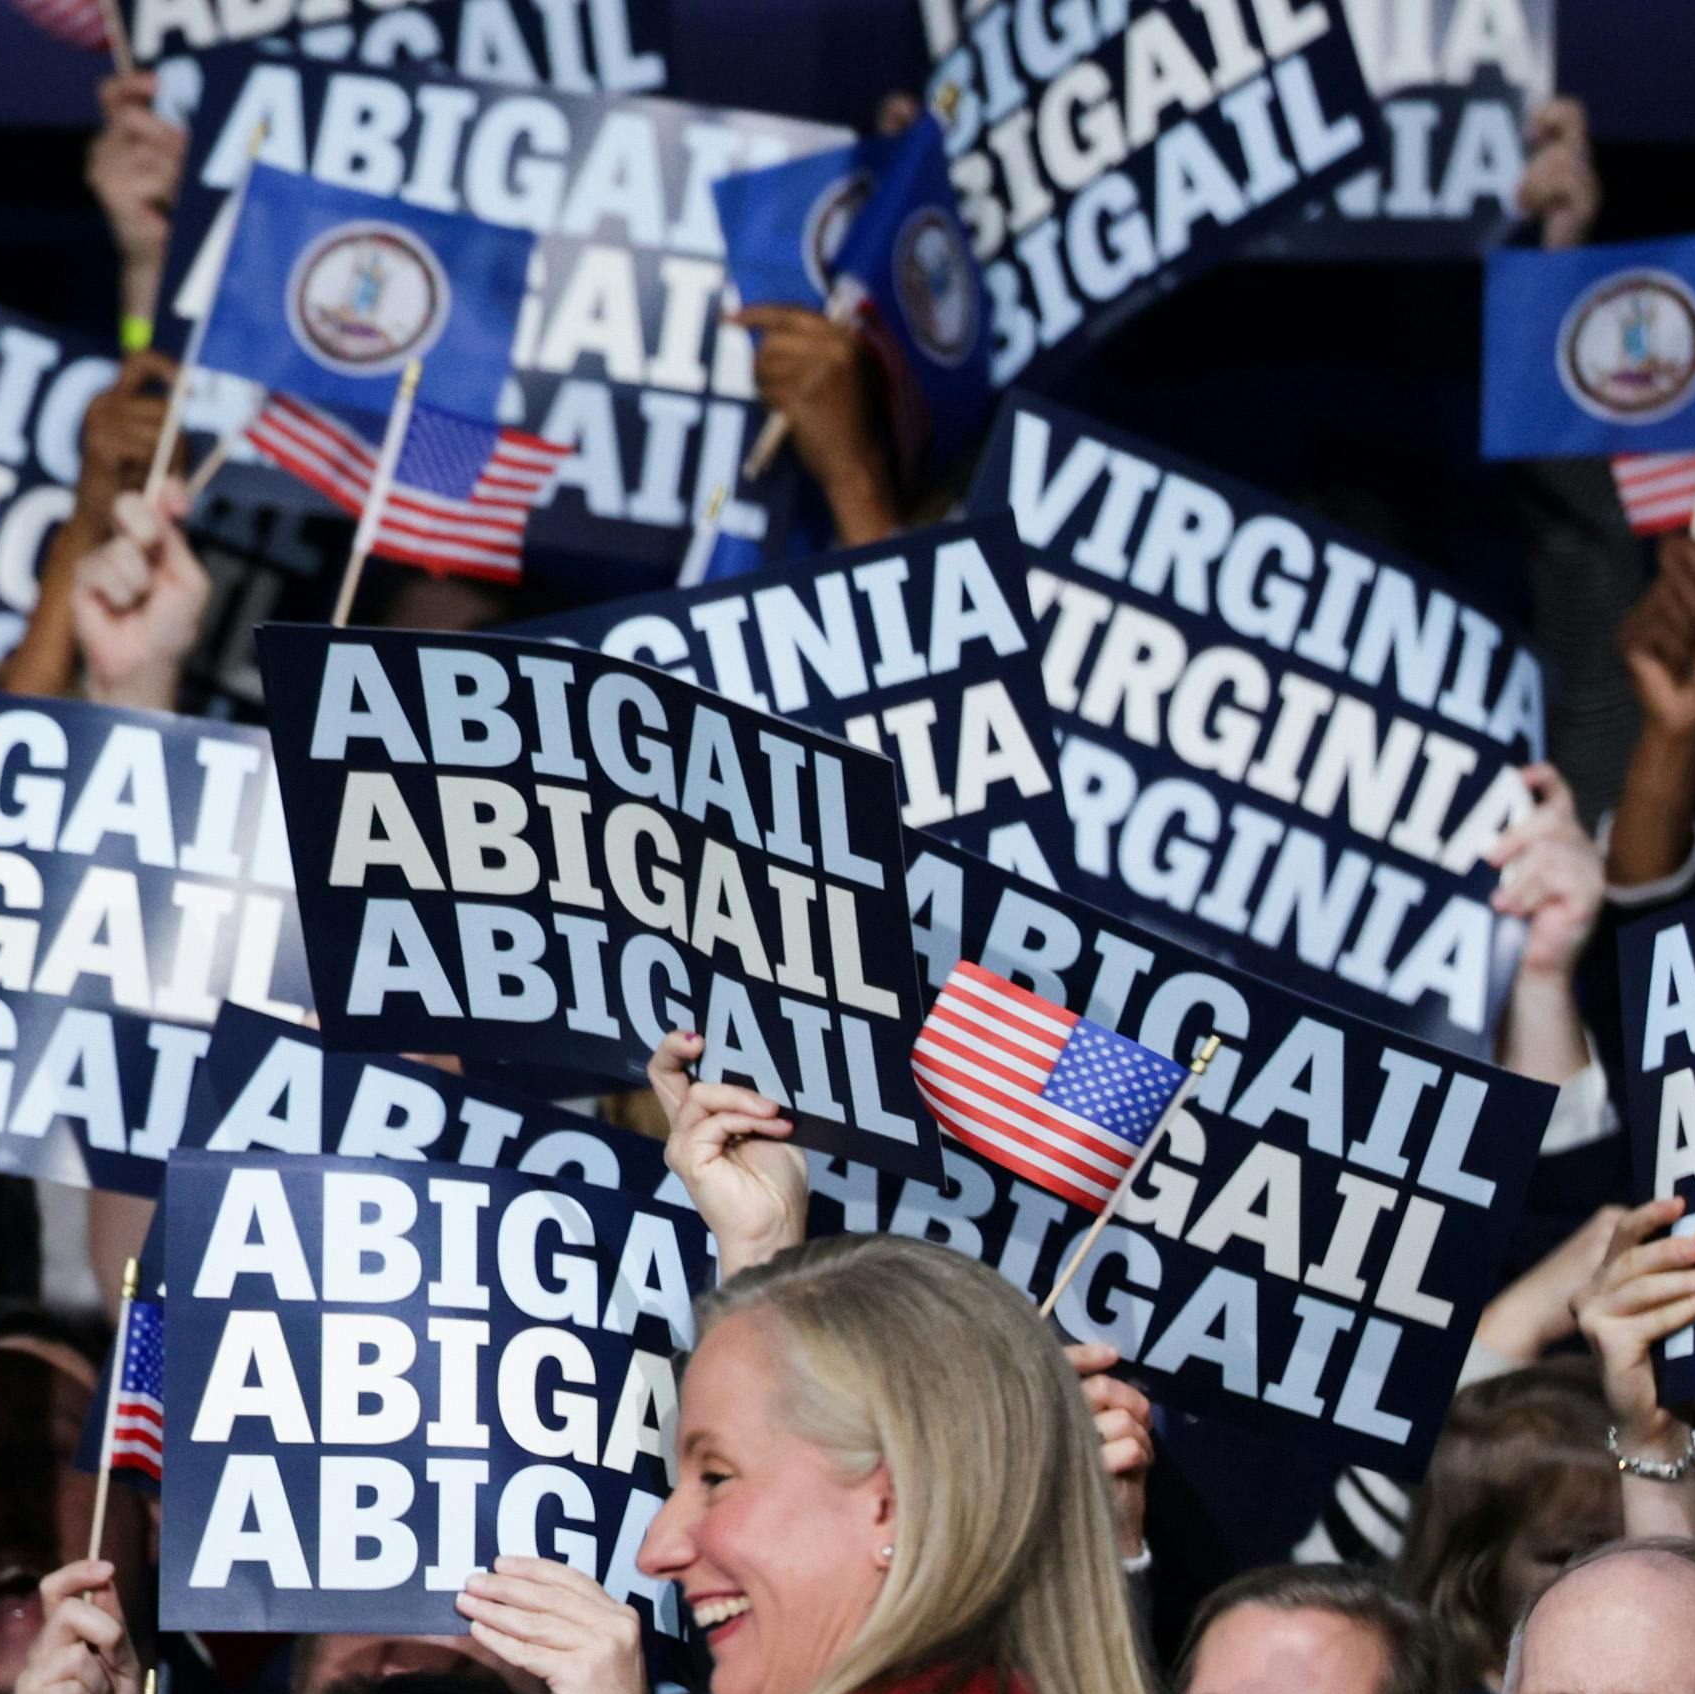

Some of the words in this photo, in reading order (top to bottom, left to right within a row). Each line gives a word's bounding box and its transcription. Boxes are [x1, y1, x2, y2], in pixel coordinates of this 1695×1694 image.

[201, 63, 791, 258] ABIGAI
[950, 0, 1331, 261] BIGAIL
[989, 54, 1364, 386] BIGAIL
[542, 537, 1028, 714] GINIA
[1008, 410, 1547, 764] VIRGINIA
[310, 642, 885, 890] ABIGAIL
[1053, 730, 1493, 1034] RGINIA
[329, 771, 900, 1020] ABIGAIL
[347, 897, 919, 1147] ABIGAIL
[191, 1168, 699, 1354] ABIGA
[1115, 1105, 1455, 1331] GAIL
[189, 1310, 679, 1476] ABIGA
